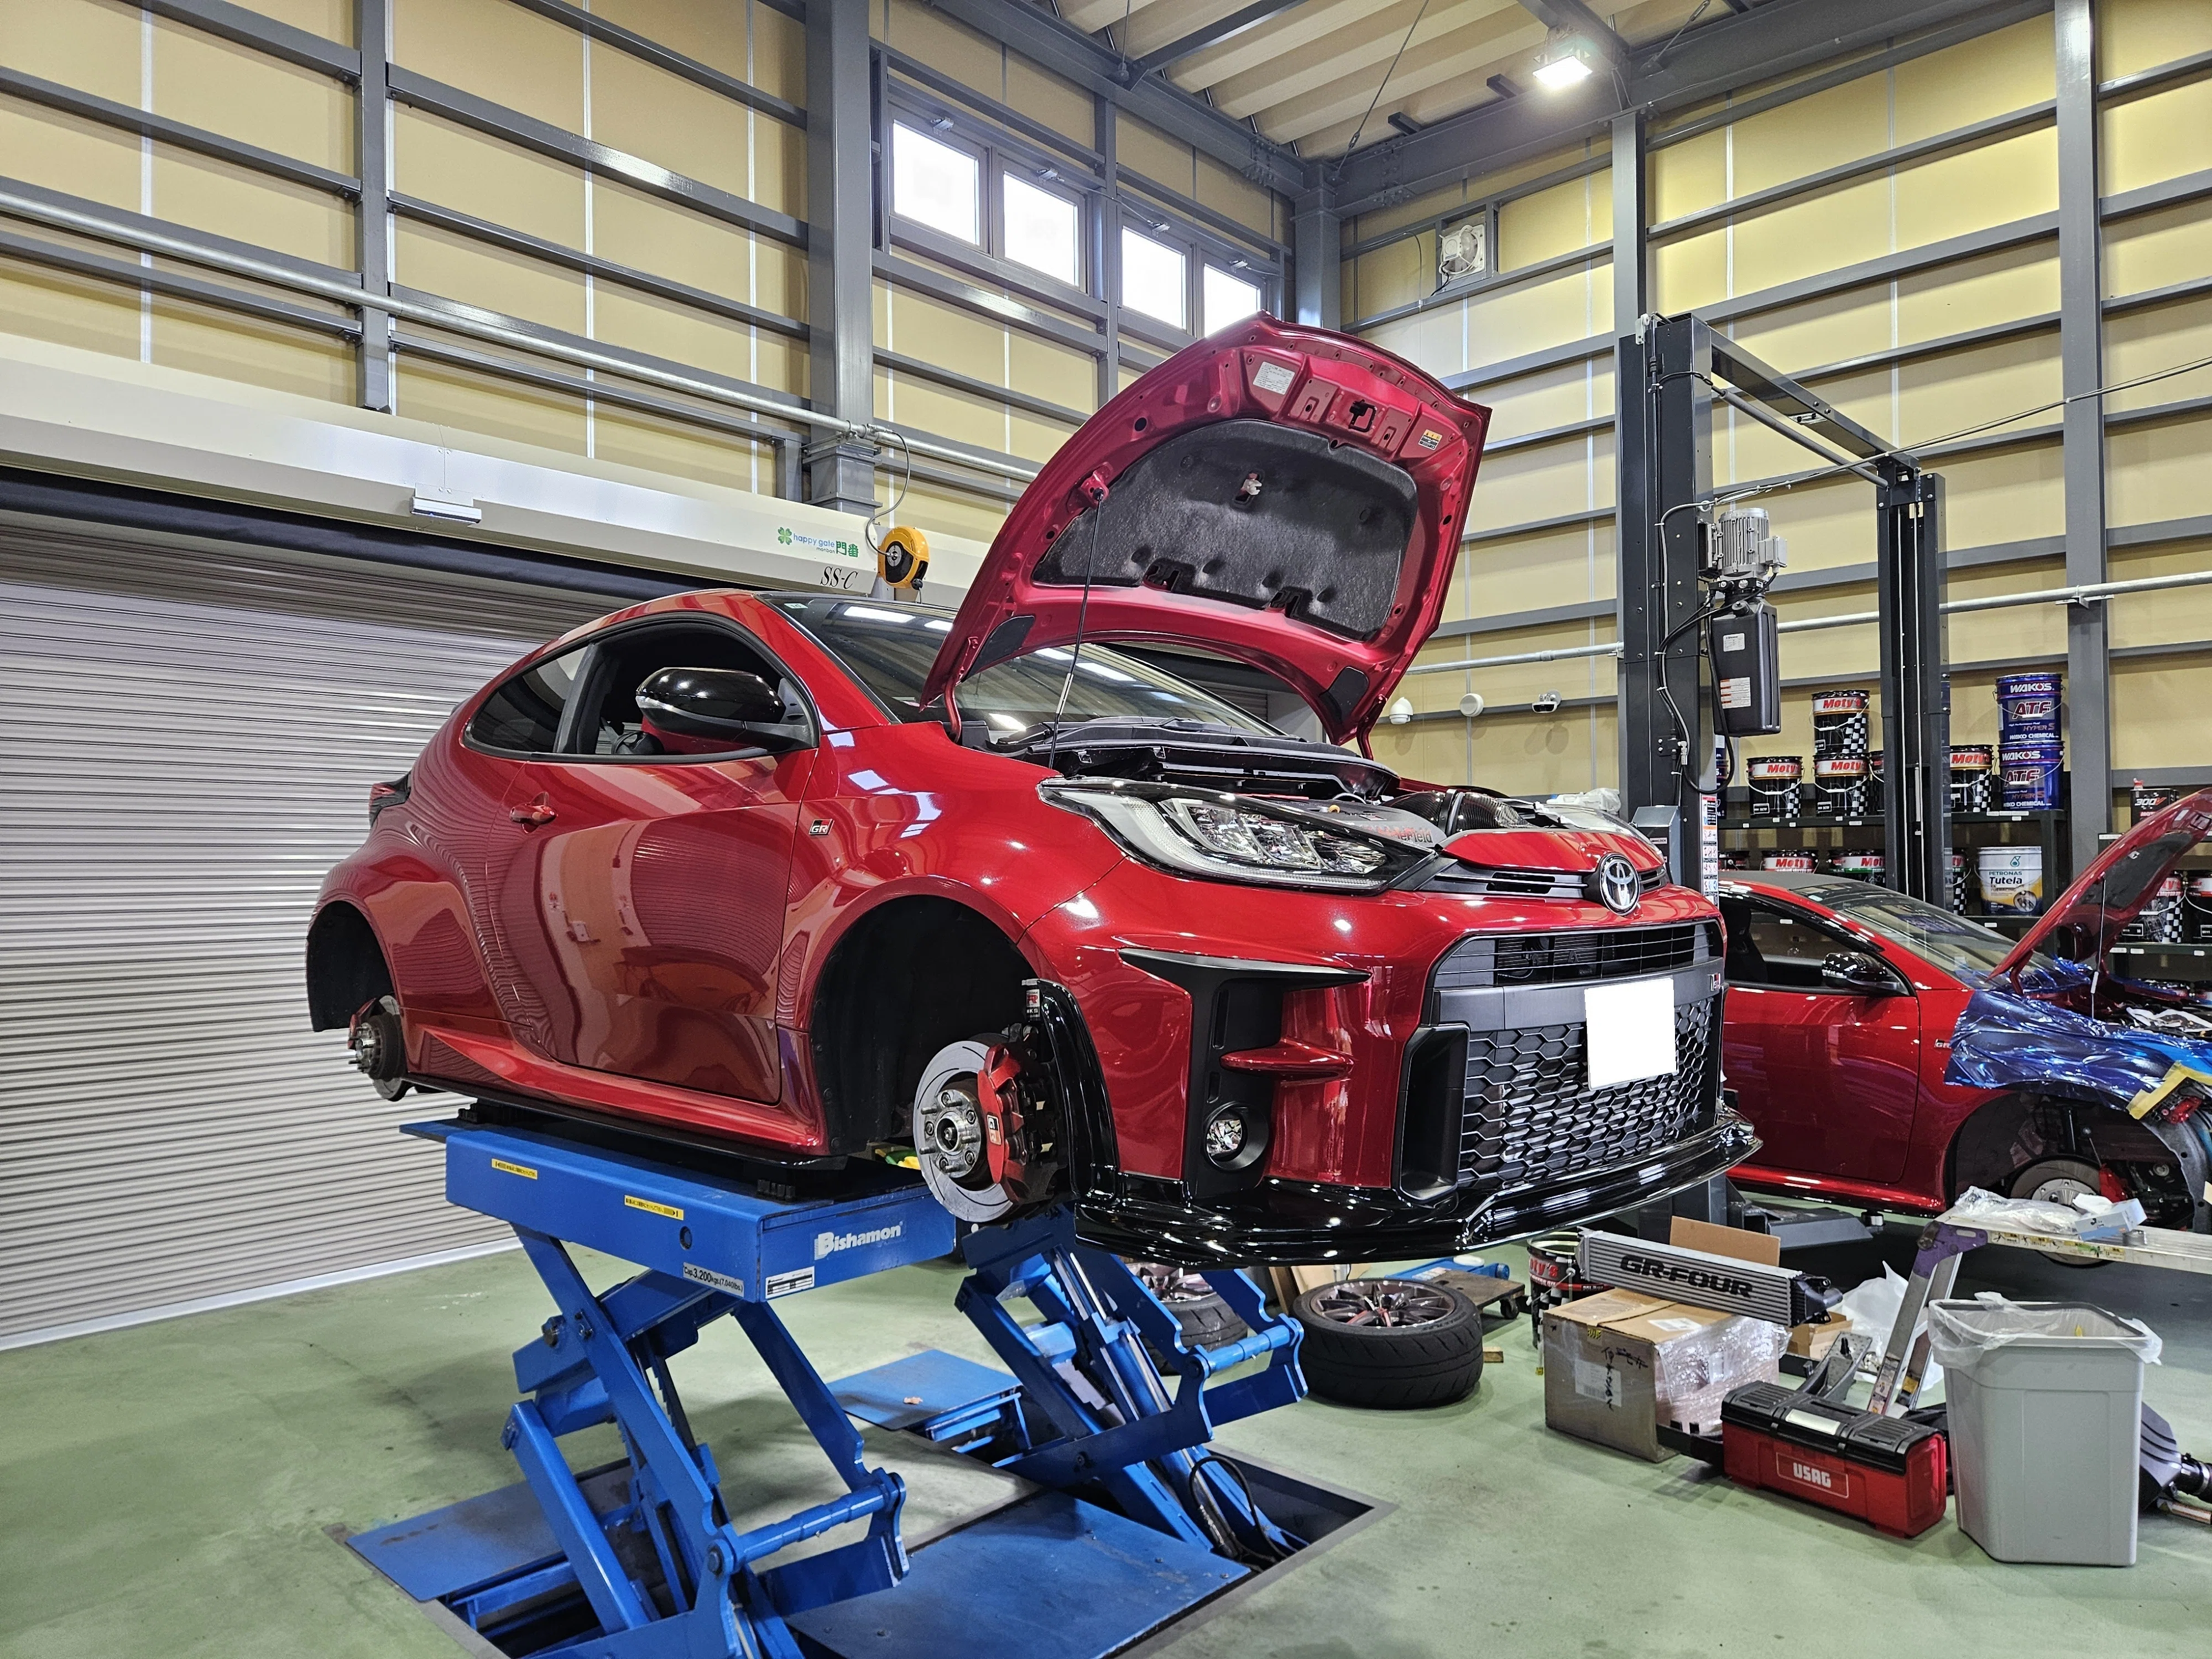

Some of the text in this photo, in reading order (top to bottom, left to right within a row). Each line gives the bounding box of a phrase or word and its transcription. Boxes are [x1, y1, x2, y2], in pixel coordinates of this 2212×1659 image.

[793, 533, 835, 547] happy gate
[836, 540, 859, 558] 門番
[820, 566, 859, 589] SS-C
[2012, 701, 2052, 719] ATF
[2048, 722, 2055, 731] S
[1951, 753, 1990, 764] Moty's
[2004, 769, 2041, 787] ATF
[2134, 797, 2167, 806] 300V
[811, 825, 828, 833] GR
[814, 1224, 901, 1260] Bishamon
[1620, 1254, 1753, 1298] GR-FOUR
[1793, 1462, 1832, 1488] USAG
